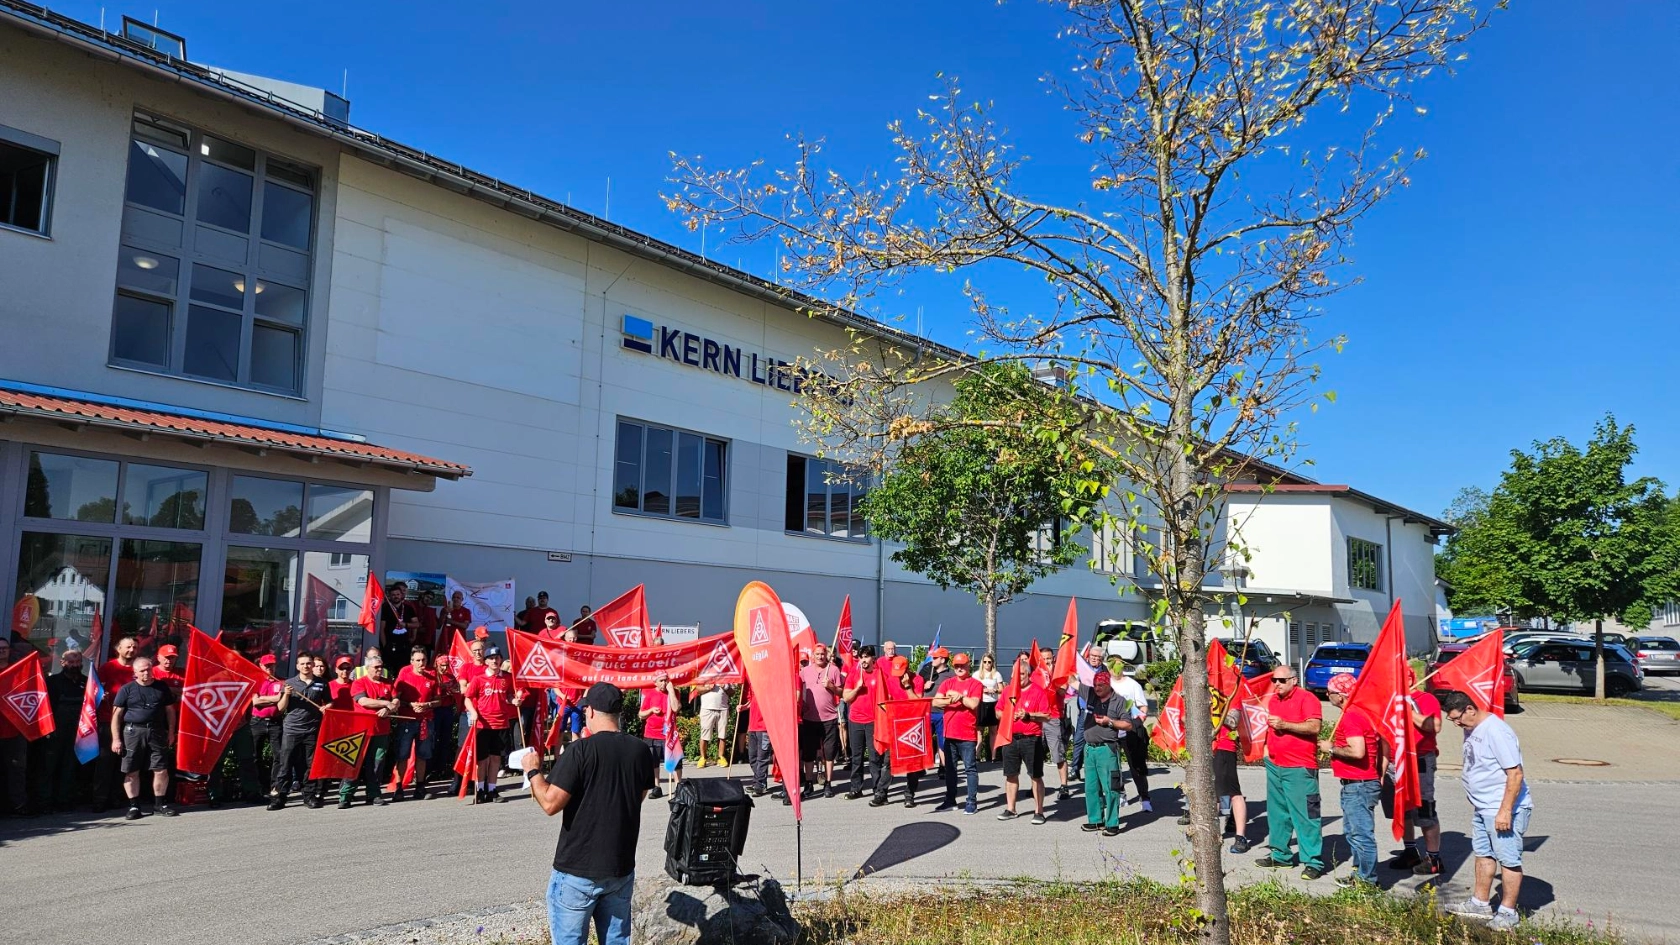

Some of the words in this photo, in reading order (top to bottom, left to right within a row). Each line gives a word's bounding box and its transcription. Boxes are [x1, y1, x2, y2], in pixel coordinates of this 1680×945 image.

[660, 325, 742, 378] KERN
[573, 650, 613, 660] gutes
[617, 651, 651, 661] geld
[655, 649, 682, 658] und
[595, 661, 627, 671] gute
[600, 674, 615, 682] für
[617, 674, 638, 682] land
